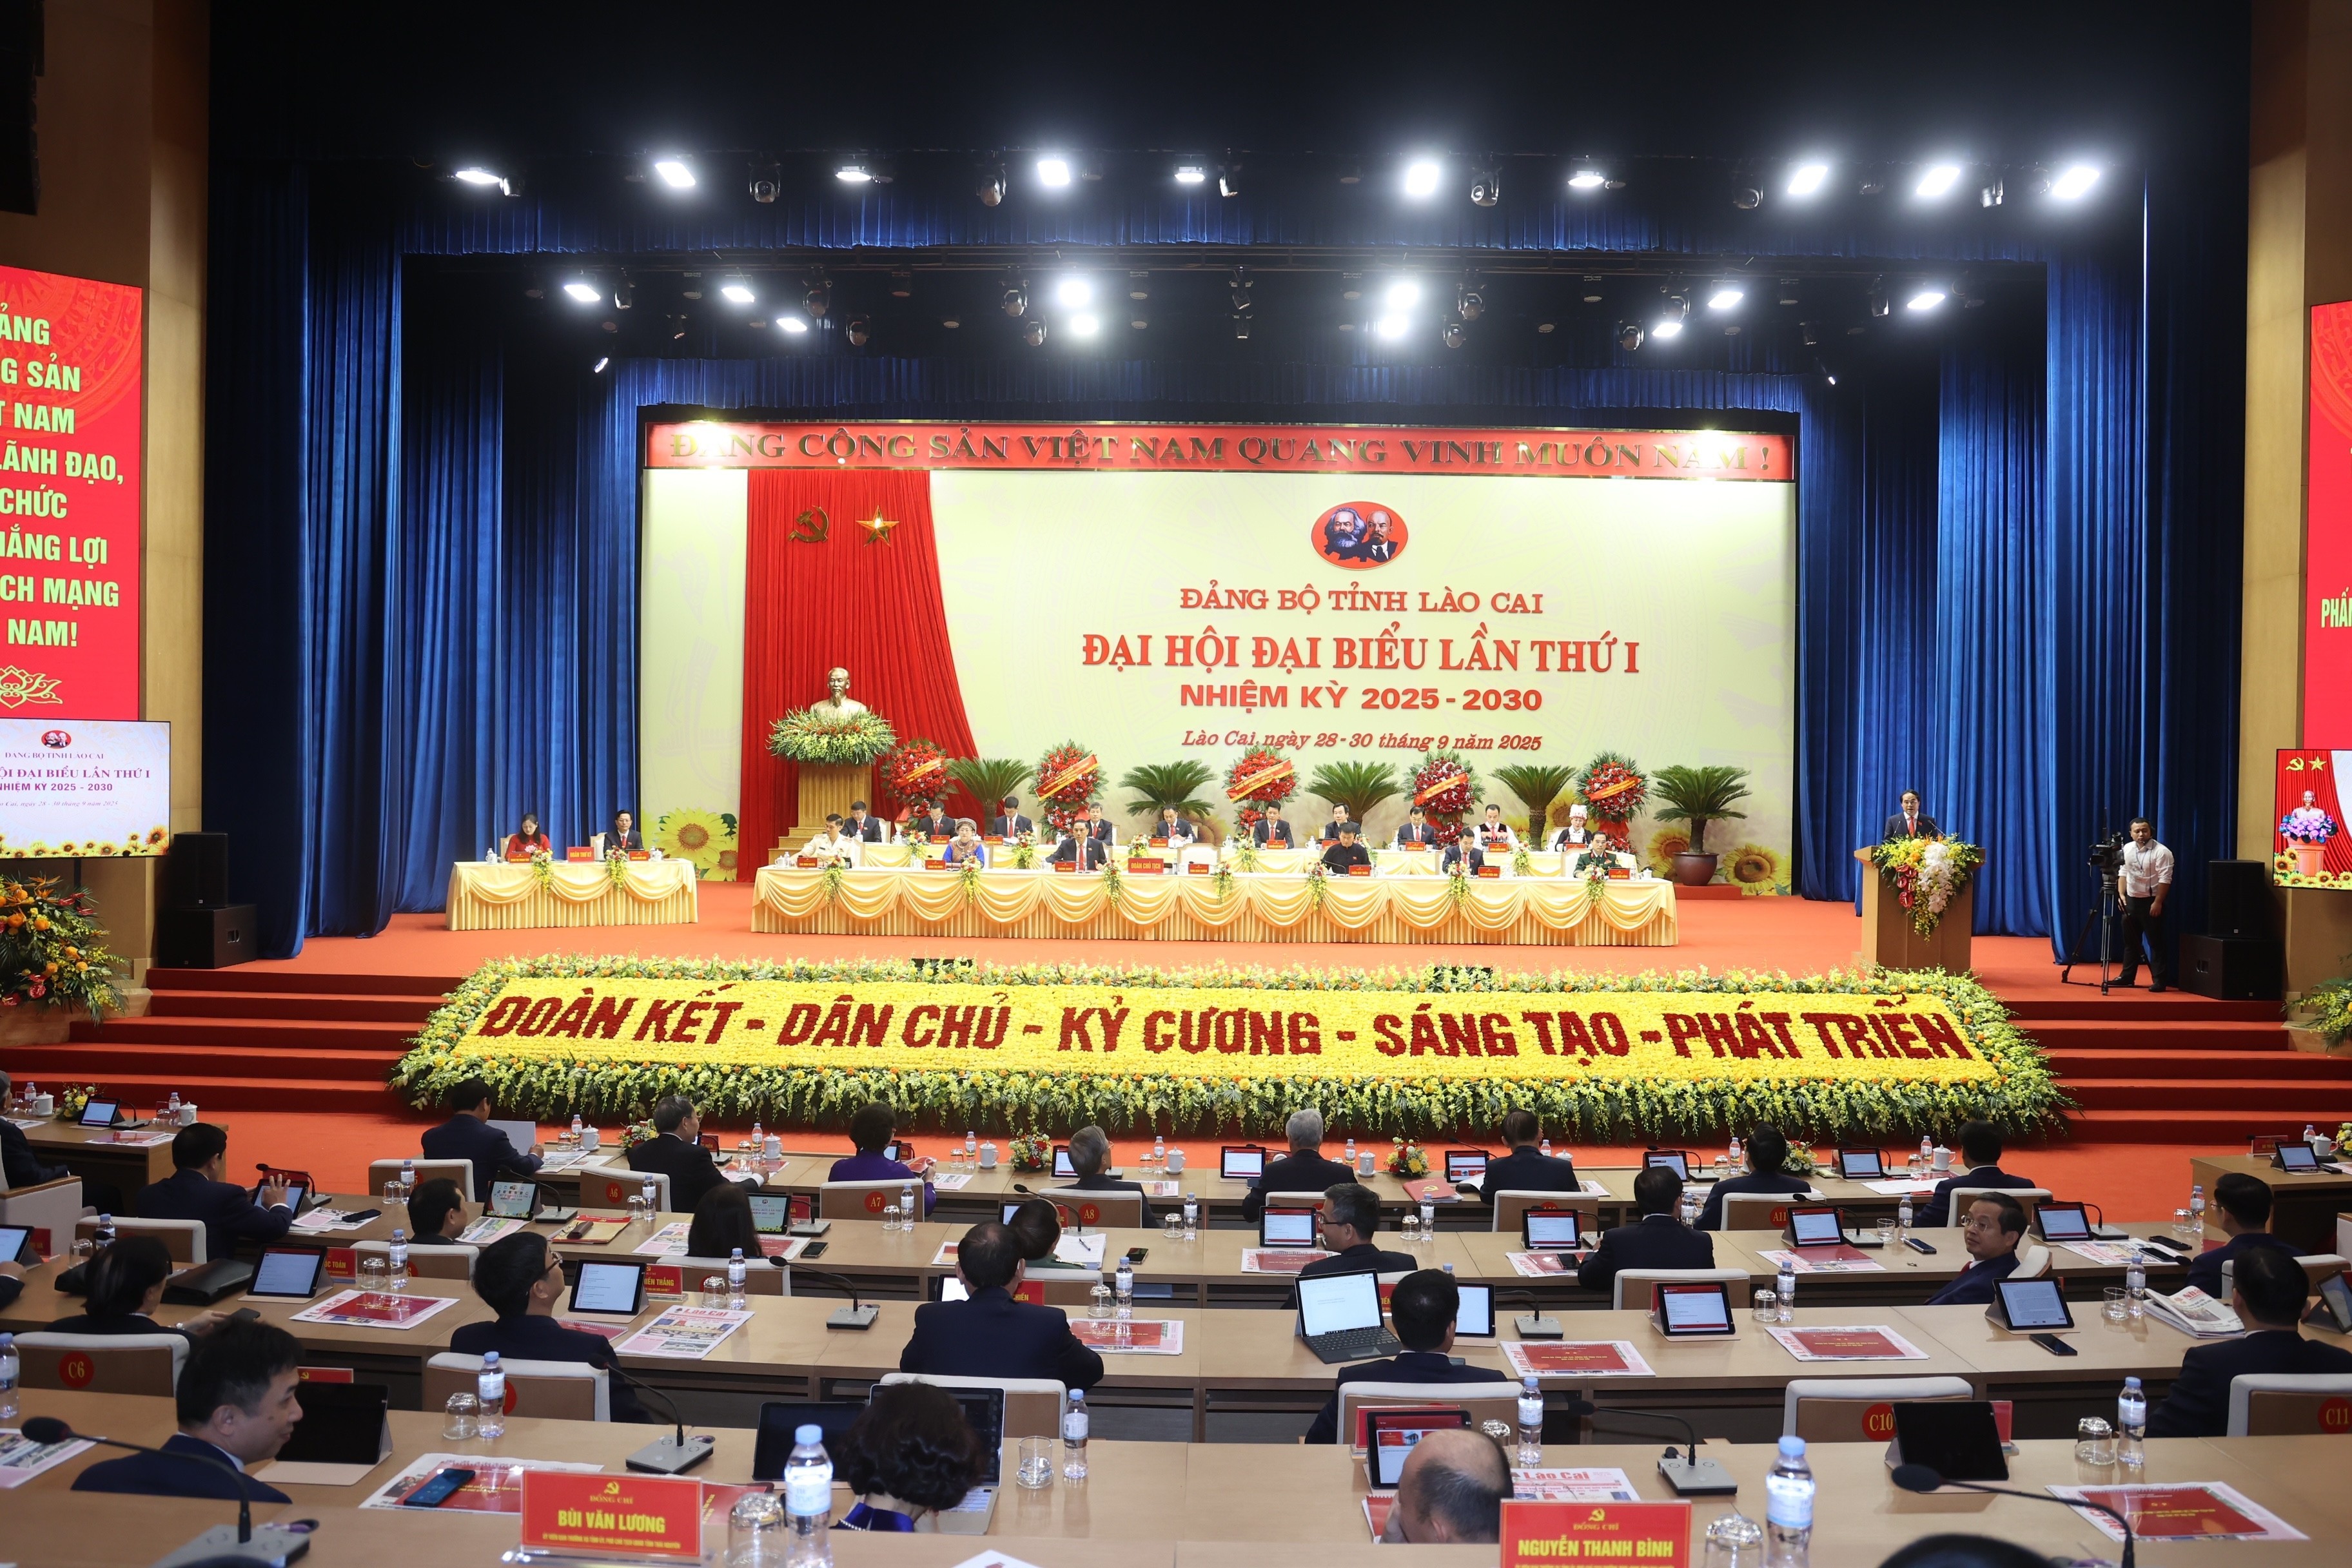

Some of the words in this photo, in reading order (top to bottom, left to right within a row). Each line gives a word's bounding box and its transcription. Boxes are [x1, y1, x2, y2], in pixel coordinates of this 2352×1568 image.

[27, 353, 80, 392] SẢN
[14, 403, 74, 434] NAM
[798, 427, 917, 464] CỘNG
[928, 427, 1007, 460] SẢN
[1017, 429, 1119, 466] VIỆT
[1130, 435, 1226, 461] NAM
[1238, 436, 1388, 464] QUANG
[1400, 438, 1504, 464] VINH
[1516, 435, 1642, 466] MUÔN
[1760, 447, 1770, 470] !
[65, 451, 122, 484] ĐẠO,
[0, 486, 66, 518] CHỨC
[70, 537, 106, 569] LỢI
[44, 578, 118, 610] MẠNG
[1181, 580, 1269, 609] ĐẢNG
[1279, 583, 1320, 614] BỘ
[1328, 582, 1407, 611] TỈNH
[1420, 587, 1480, 612] LÀO
[1491, 593, 1543, 613] CAI
[8, 619, 77, 647] NAM!
[1083, 634, 1152, 671] ĐẠI
[1166, 625, 1239, 673] HỘI
[1252, 637, 1320, 674] ĐẠI
[1334, 621, 1427, 670] BIỂU
[1440, 622, 1520, 671] LẦN
[1531, 631, 1617, 672] THỨ
[1625, 642, 1639, 673] I
[1181, 680, 1288, 713] NHIỆM
[1301, 680, 1348, 707] KỲ
[1362, 688, 1440, 709] 2025
[1463, 689, 1542, 710] 2030
[1183, 730, 1219, 745] Lào
[1264, 732, 1310, 750] ngày
[1316, 733, 1338, 747] 28
[1349, 733, 1373, 747] 30
[1380, 734, 1434, 752] tháng
[1438, 735, 1449, 749] 9
[1454, 735, 1494, 749] năm
[1499, 735, 1542, 750] 2025
[17, 769, 42, 779] ĐẠI
[46, 765, 79, 778] BIỂU
[83, 765, 110, 778] LẦN
[114, 767, 142, 778] THỨ
[145, 770, 150, 778] I
[34, 781, 47, 791] KỲ
[51, 783, 76, 791] 2025
[88, 783, 113, 791] 2030
[1143, 861, 1152, 869] CHỦ
[476, 988, 635, 1039] ĐOÀN
[634, 984, 744, 1044] KẾT
[778, 995, 894, 1046] DÂN
[901, 993, 1011, 1050] CHỦ
[1058, 996, 1130, 1052] KỶ
[1374, 1004, 1519, 1057] SÁNG
[1522, 1012, 1629, 1066] TẠO
[1661, 1001, 1803, 1059] PHÁT
[1801, 992, 1974, 1059] TRIỂN
[609, 1187, 618, 1198] A6
[870, 1197, 881, 1208] A7
[1084, 1208, 1095, 1219] A8
[1773, 1211, 1787, 1222] A11
[1014, 1292, 1029, 1301] HIẾN
[68, 1362, 85, 1378] C6
[1869, 1413, 1894, 1432] C10
[2326, 1407, 2349, 1426] C11
[558, 1507, 582, 1527] BÙI
[585, 1509, 615, 1530] VĂN
[618, 1513, 666, 1534] LƯƠNG
[1518, 1534, 1580, 1557] NGUYỄN
[1583, 1540, 1633, 1558] THANH
[1636, 1536, 1674, 1558] BÌNH
